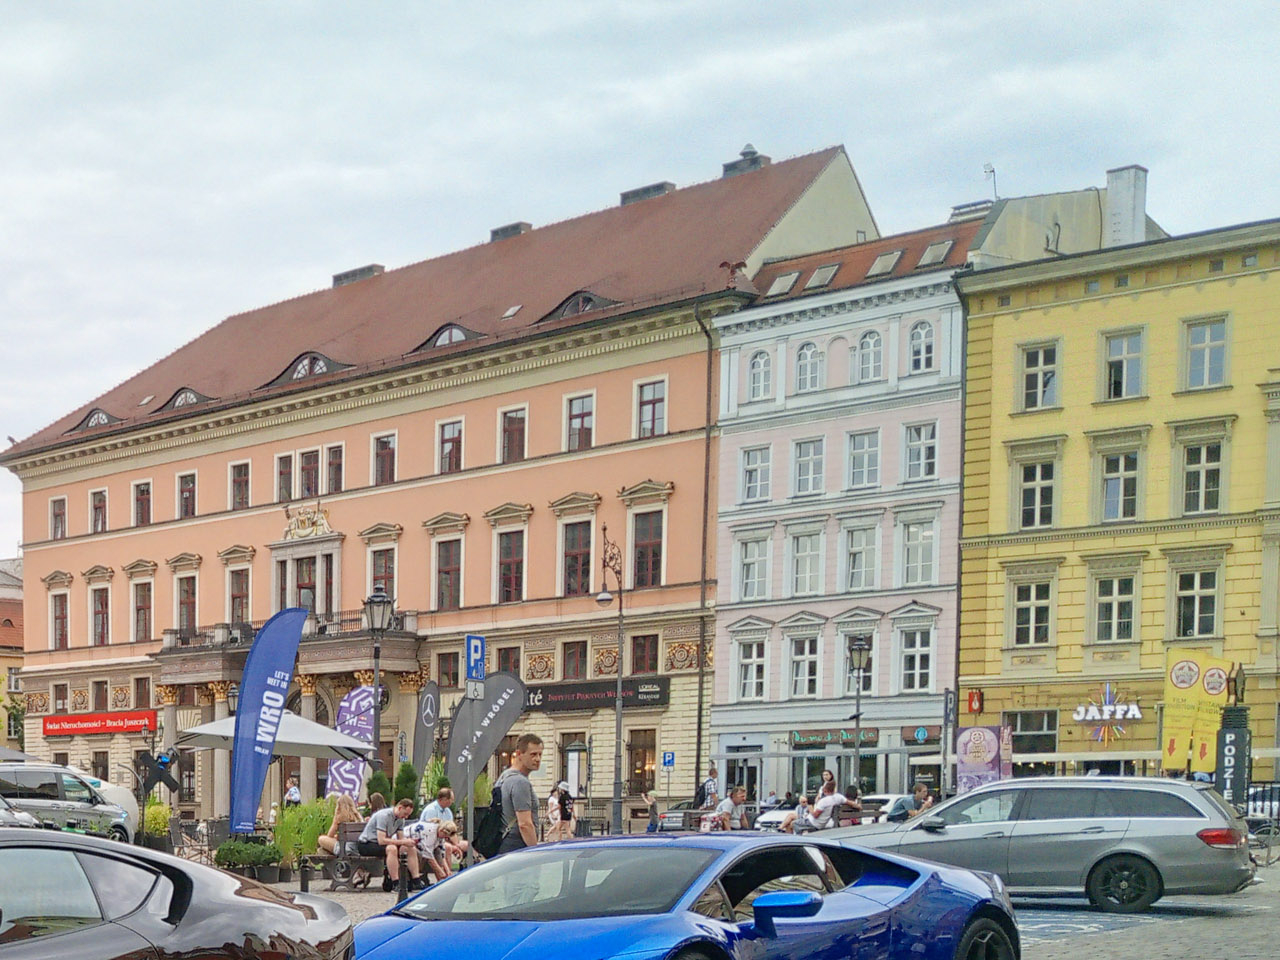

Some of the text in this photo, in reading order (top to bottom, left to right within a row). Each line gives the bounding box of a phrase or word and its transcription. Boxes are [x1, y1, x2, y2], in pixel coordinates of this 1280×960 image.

[470, 639, 481, 667] P
[256, 690, 284, 743] WRO
[481, 688, 515, 727] WRÓBEL
[1072, 704, 1142, 721] JAFFA
